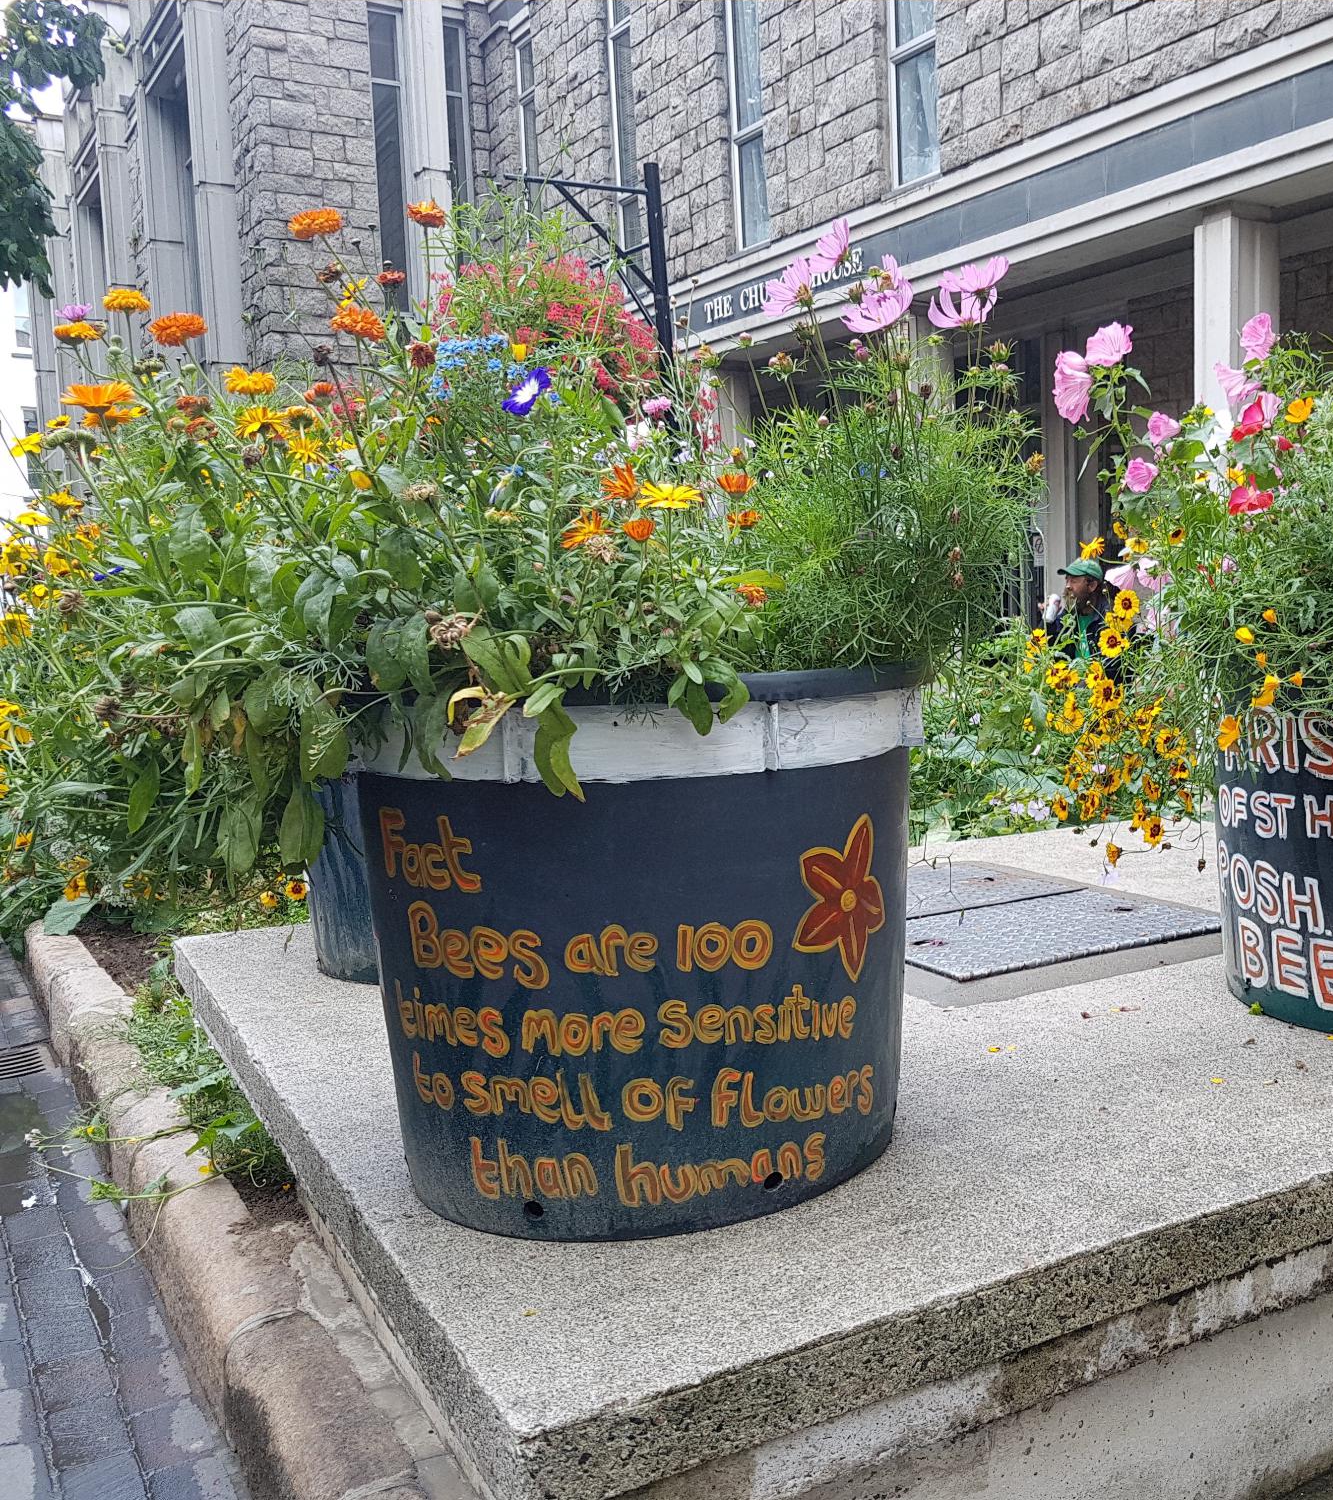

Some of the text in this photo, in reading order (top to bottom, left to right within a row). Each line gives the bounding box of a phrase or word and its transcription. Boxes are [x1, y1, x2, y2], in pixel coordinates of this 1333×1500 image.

[704, 294, 734, 323] THE
[379, 806, 482, 894] Fact
[1218, 784, 1247, 828] OF
[1250, 791, 1295, 840] ST
[408, 901, 773, 991] Bees are 100
[395, 978, 511, 1058] times
[522, 1008, 646, 1057] more
[413, 1052, 454, 1111] to
[470, 1131, 827, 1208] than humans
